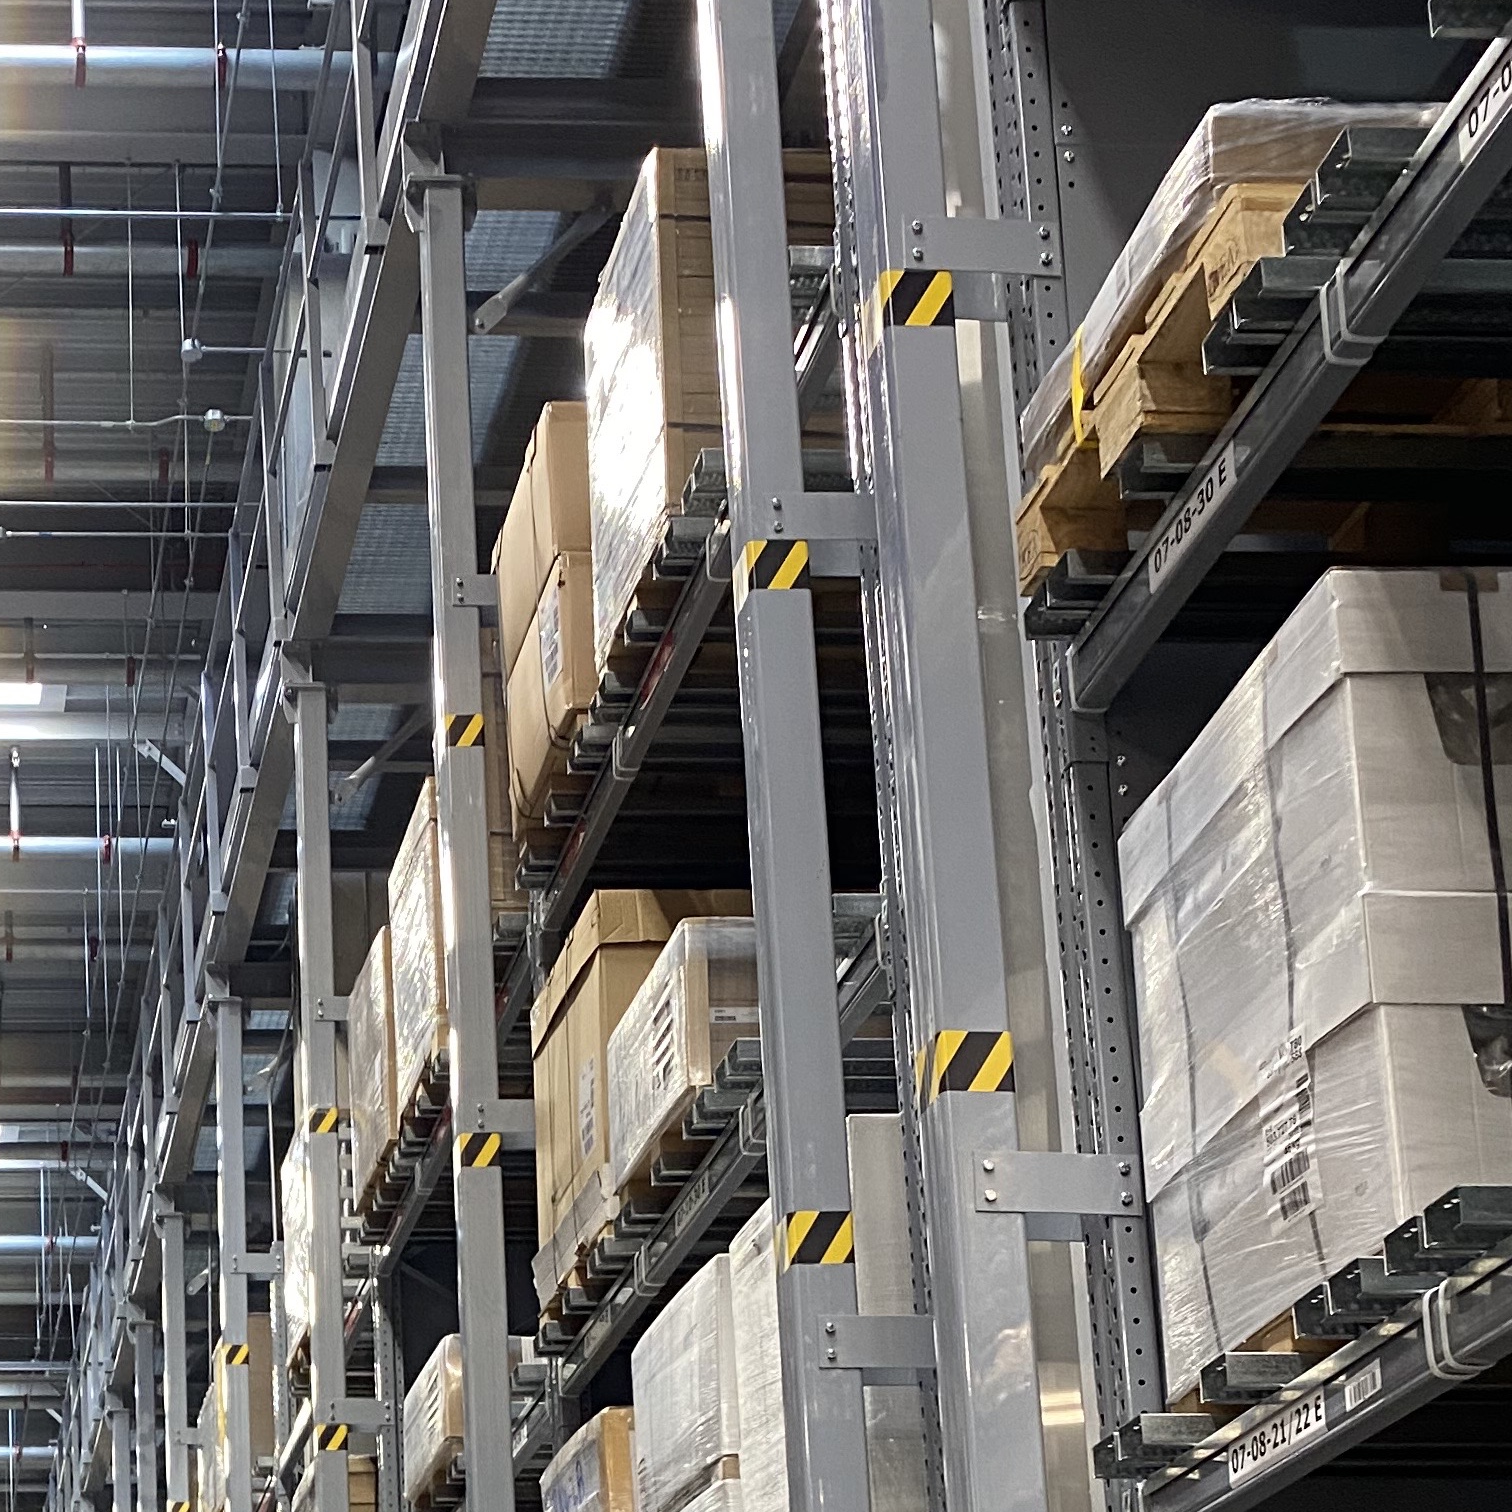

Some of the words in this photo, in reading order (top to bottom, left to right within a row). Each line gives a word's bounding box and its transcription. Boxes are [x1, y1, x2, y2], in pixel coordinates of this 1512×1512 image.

[1154, 476, 1214, 573] 07-08-30
[1218, 457, 1227, 487] E
[1231, 1403, 1311, 1474] 07-08-21/22
[1314, 1394, 1323, 1422] E
